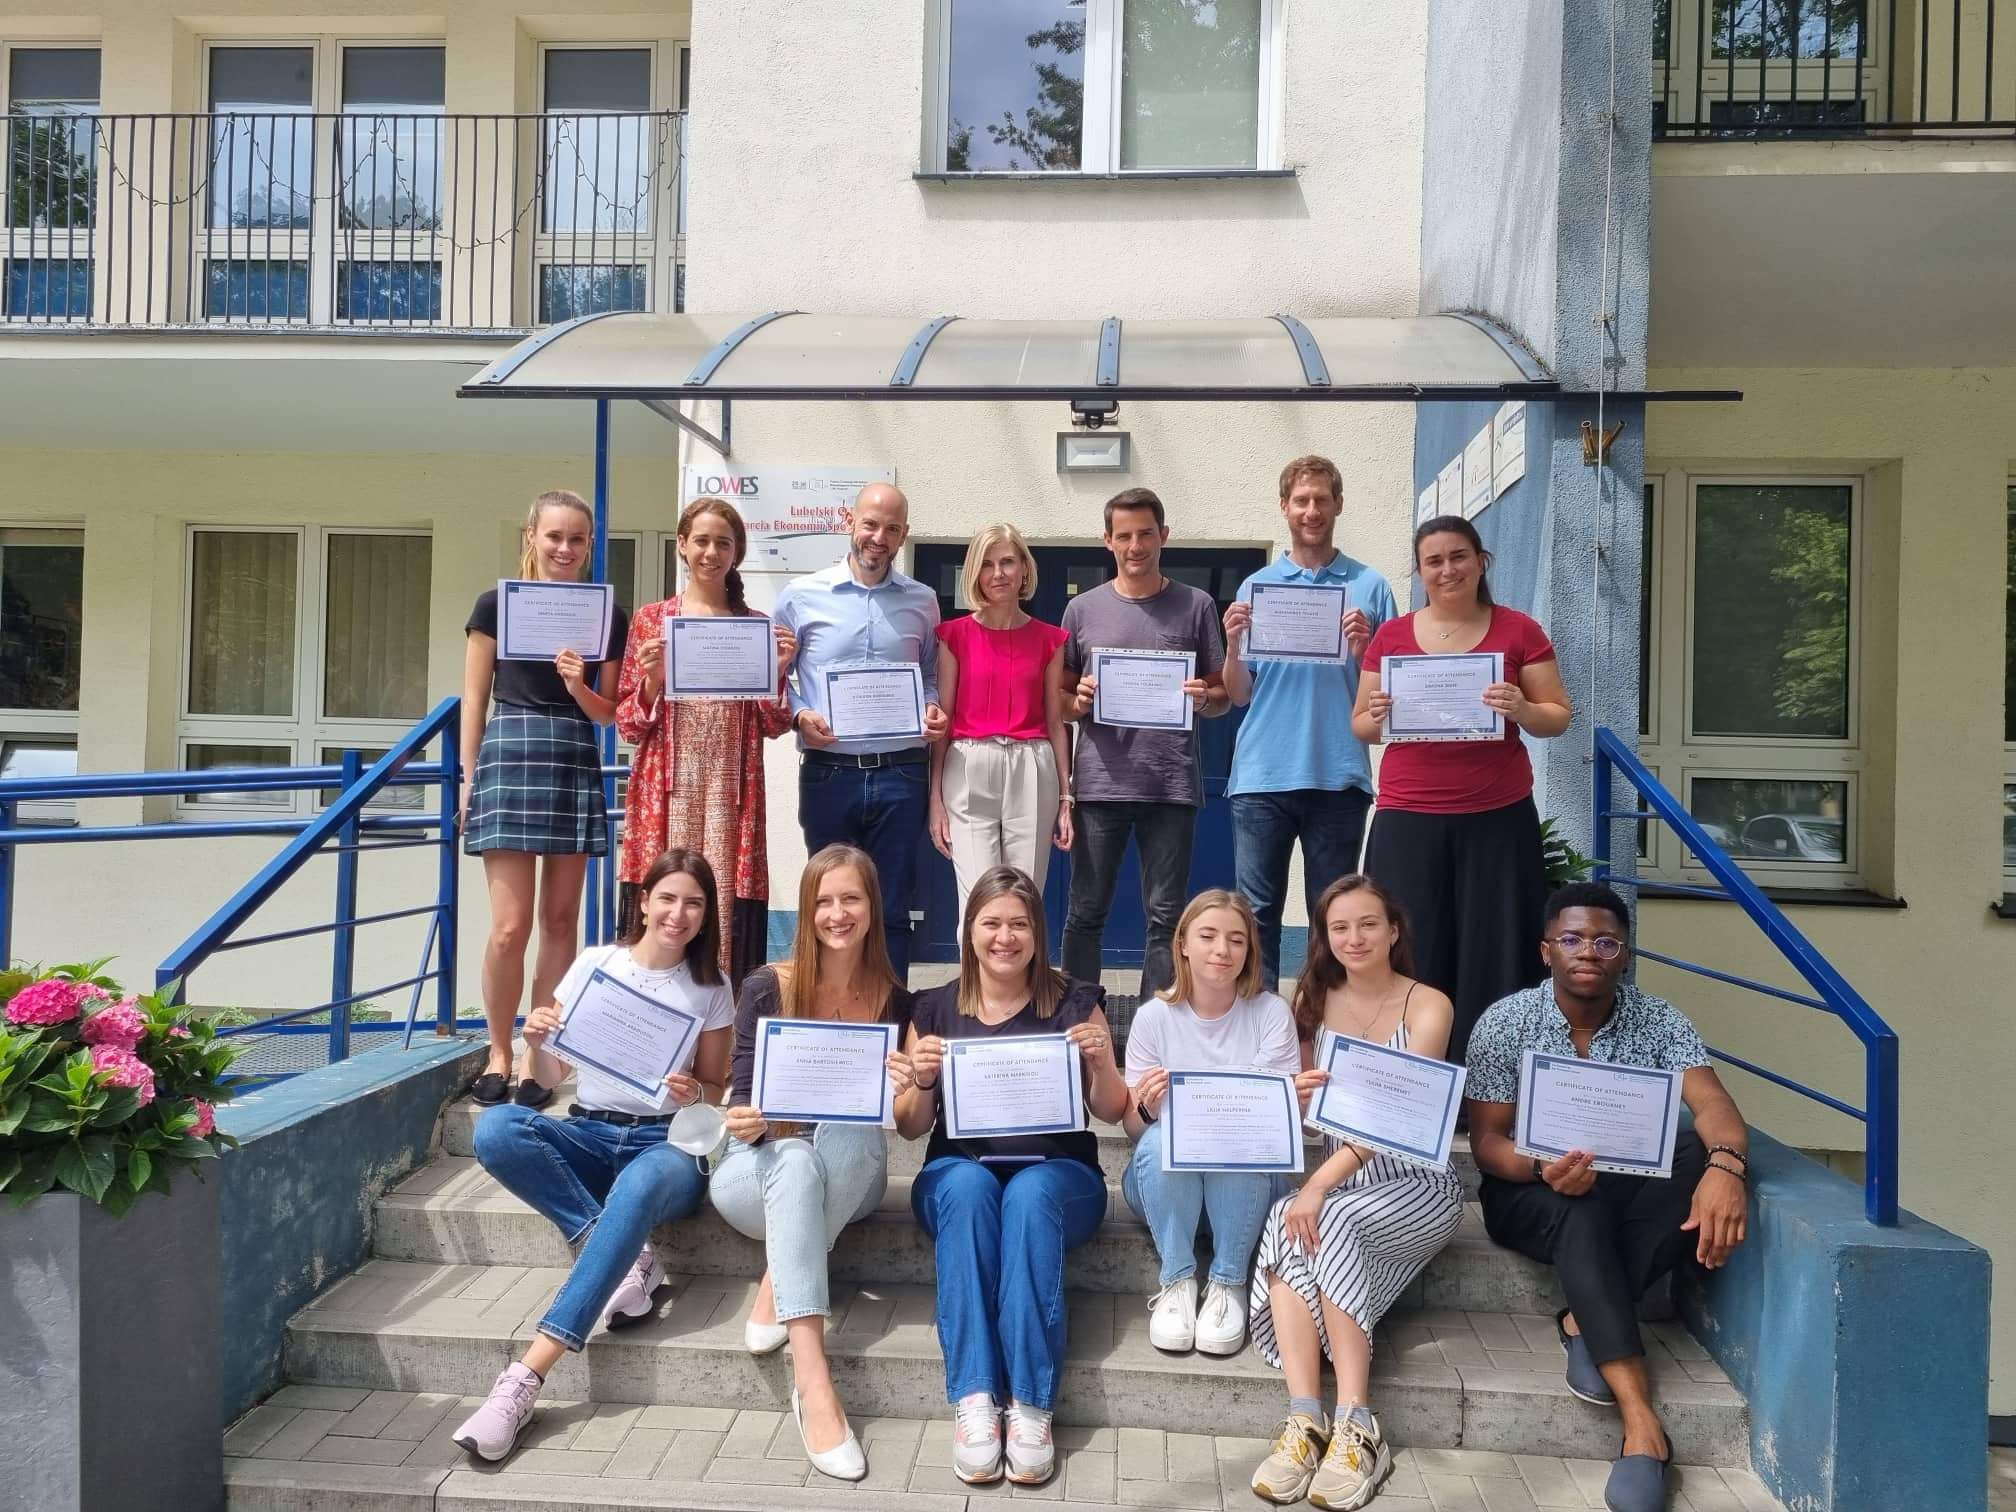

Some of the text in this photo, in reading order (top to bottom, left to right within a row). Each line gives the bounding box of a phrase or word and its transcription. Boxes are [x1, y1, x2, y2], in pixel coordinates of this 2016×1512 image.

[696, 476, 759, 494] LOWES
[790, 506, 833, 516] Lubelski
[1555, 1081, 1593, 1092] CERTIFICATE
[1605, 1089, 1645, 1099] ATTENDANCE
